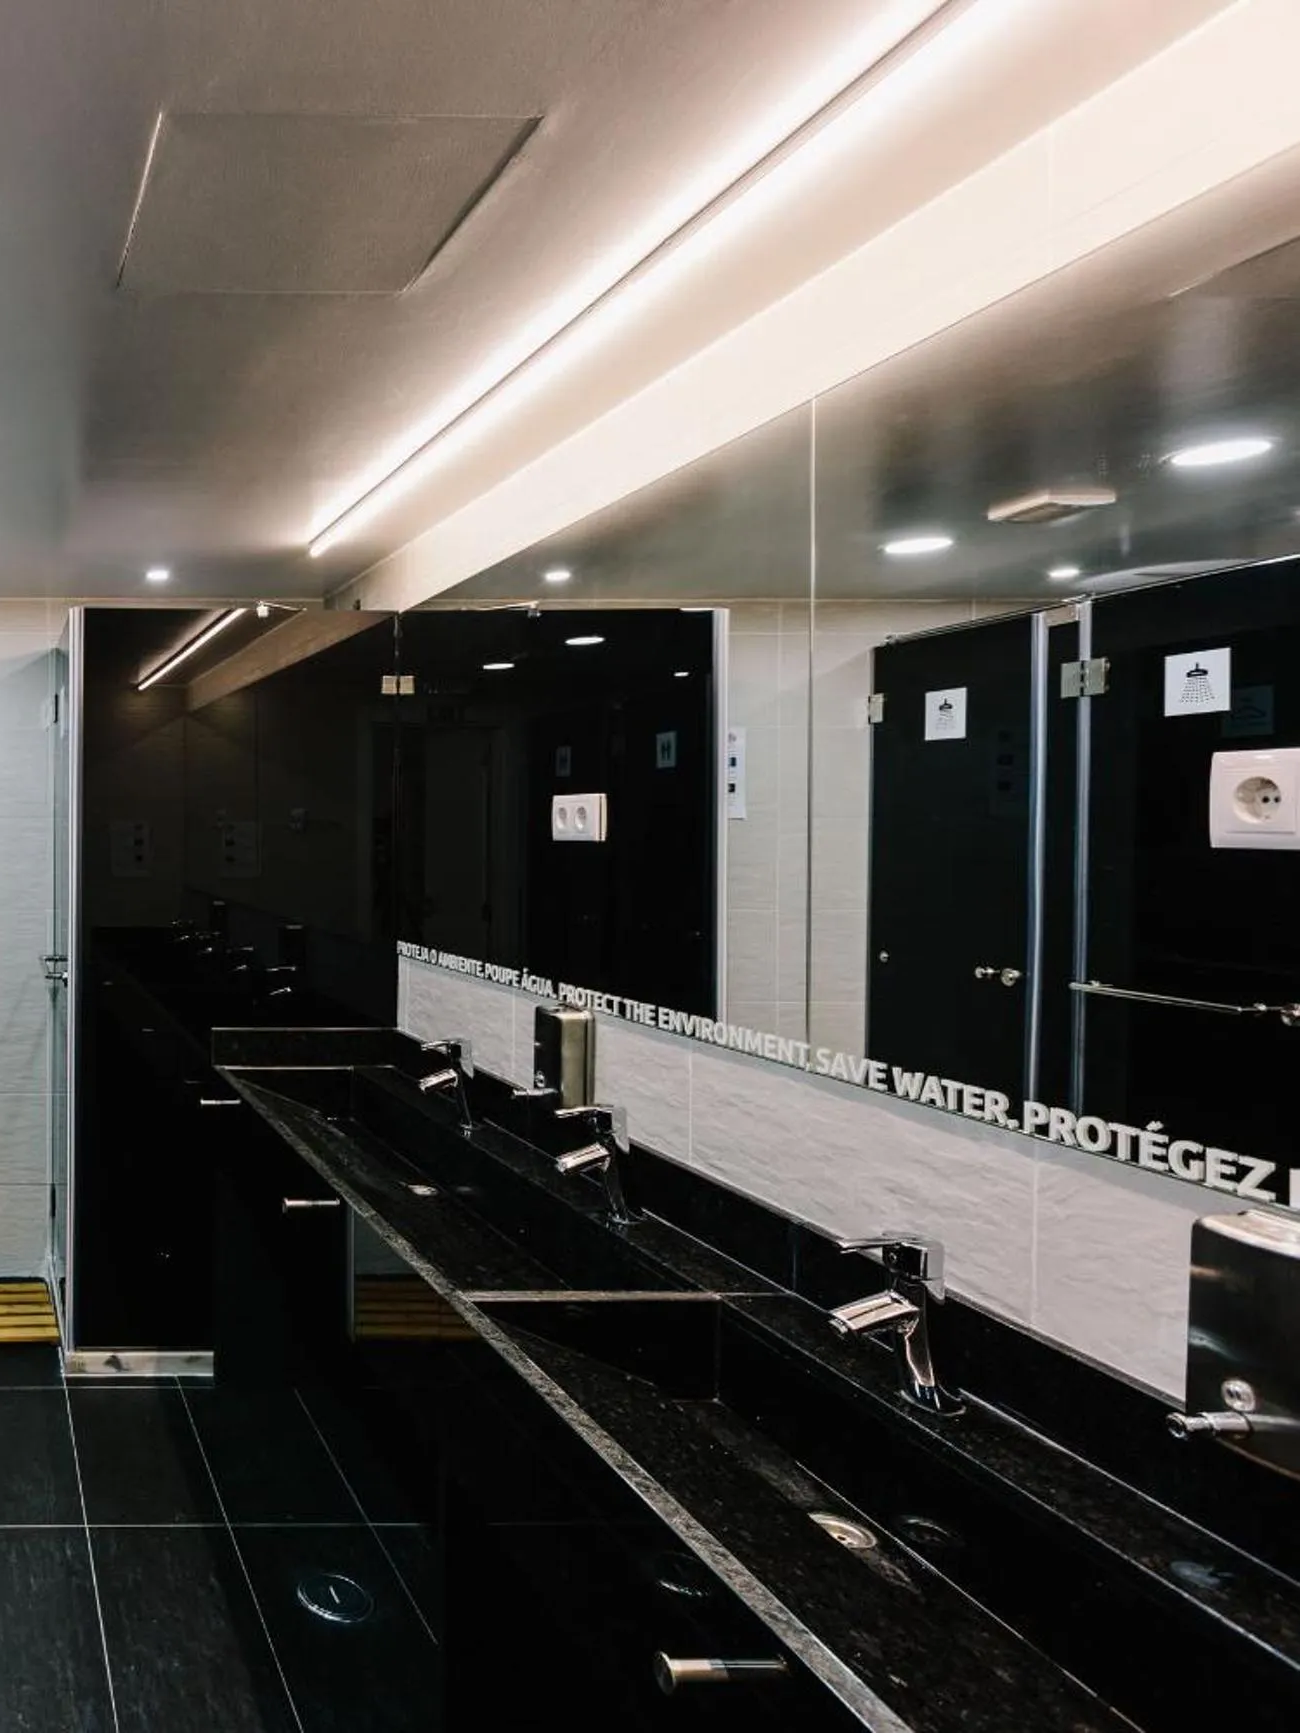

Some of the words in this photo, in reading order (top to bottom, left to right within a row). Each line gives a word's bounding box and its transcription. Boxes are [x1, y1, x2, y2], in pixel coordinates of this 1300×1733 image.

[397, 940, 429, 963] PROTEJA
[430, 949, 437, 964] O
[485, 963, 520, 987] POUPE
[558, 982, 621, 1017] PROTECT
[623, 998, 657, 1026] THE
[815, 1047, 888, 1092] SAVE
[892, 1067, 1019, 1130] WATER.
[1023, 1101, 1277, 1202] PROTÉGEZ
